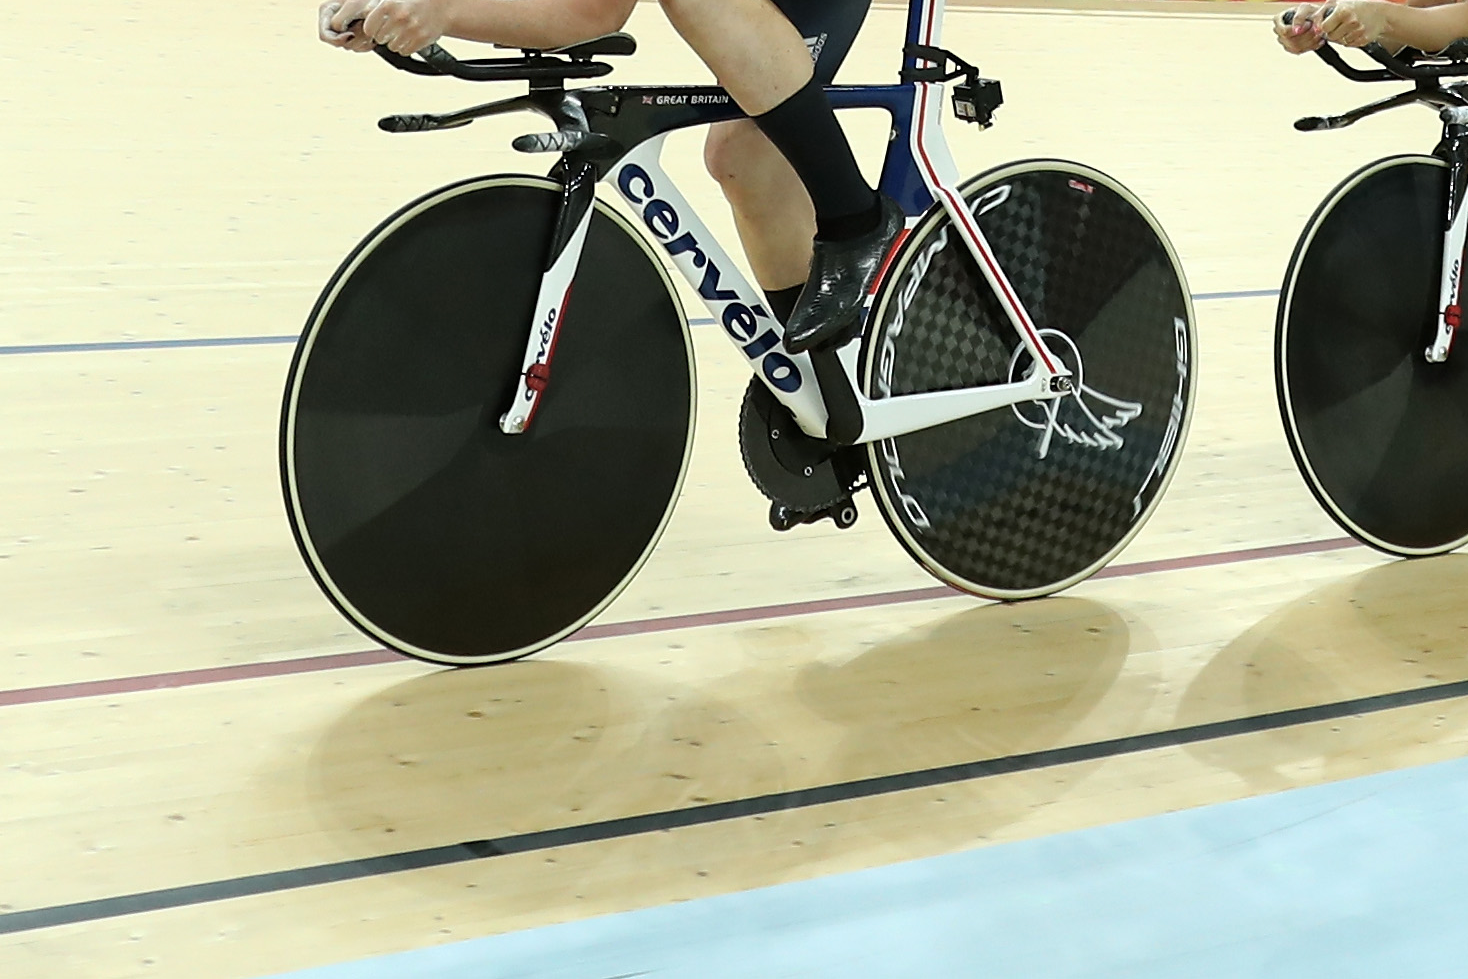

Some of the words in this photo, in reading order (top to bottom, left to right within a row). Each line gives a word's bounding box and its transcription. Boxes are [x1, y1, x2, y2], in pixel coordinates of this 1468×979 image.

[656, 96, 687, 105] GREAT
[691, 95, 729, 104] BRITAIN
[617, 162, 804, 394] cervélo
